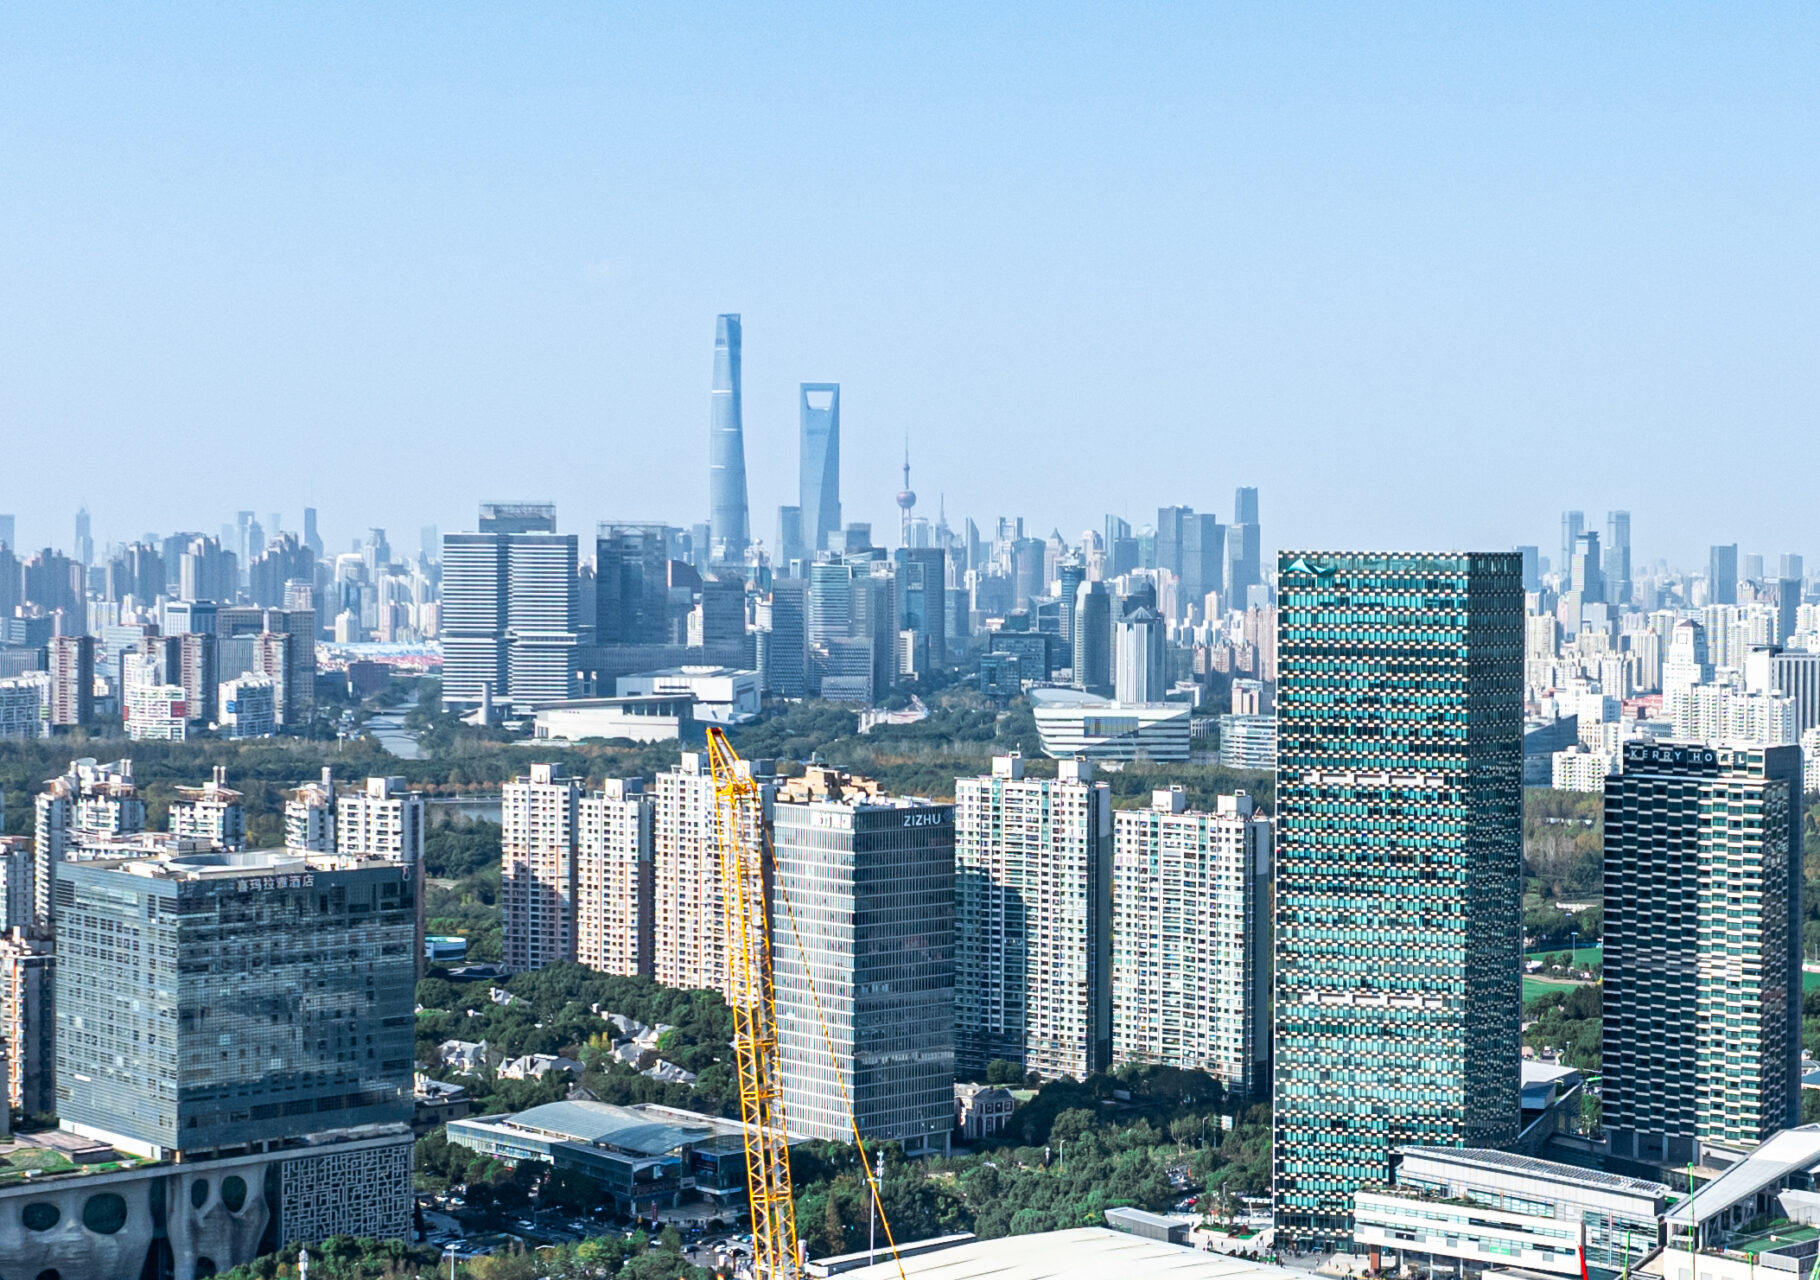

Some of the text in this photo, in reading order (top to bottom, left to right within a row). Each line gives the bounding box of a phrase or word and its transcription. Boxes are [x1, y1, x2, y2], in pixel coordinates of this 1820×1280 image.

[1630, 750, 1746, 765] KERRY HOTEL
[903, 813, 941, 827] ZIZHU
